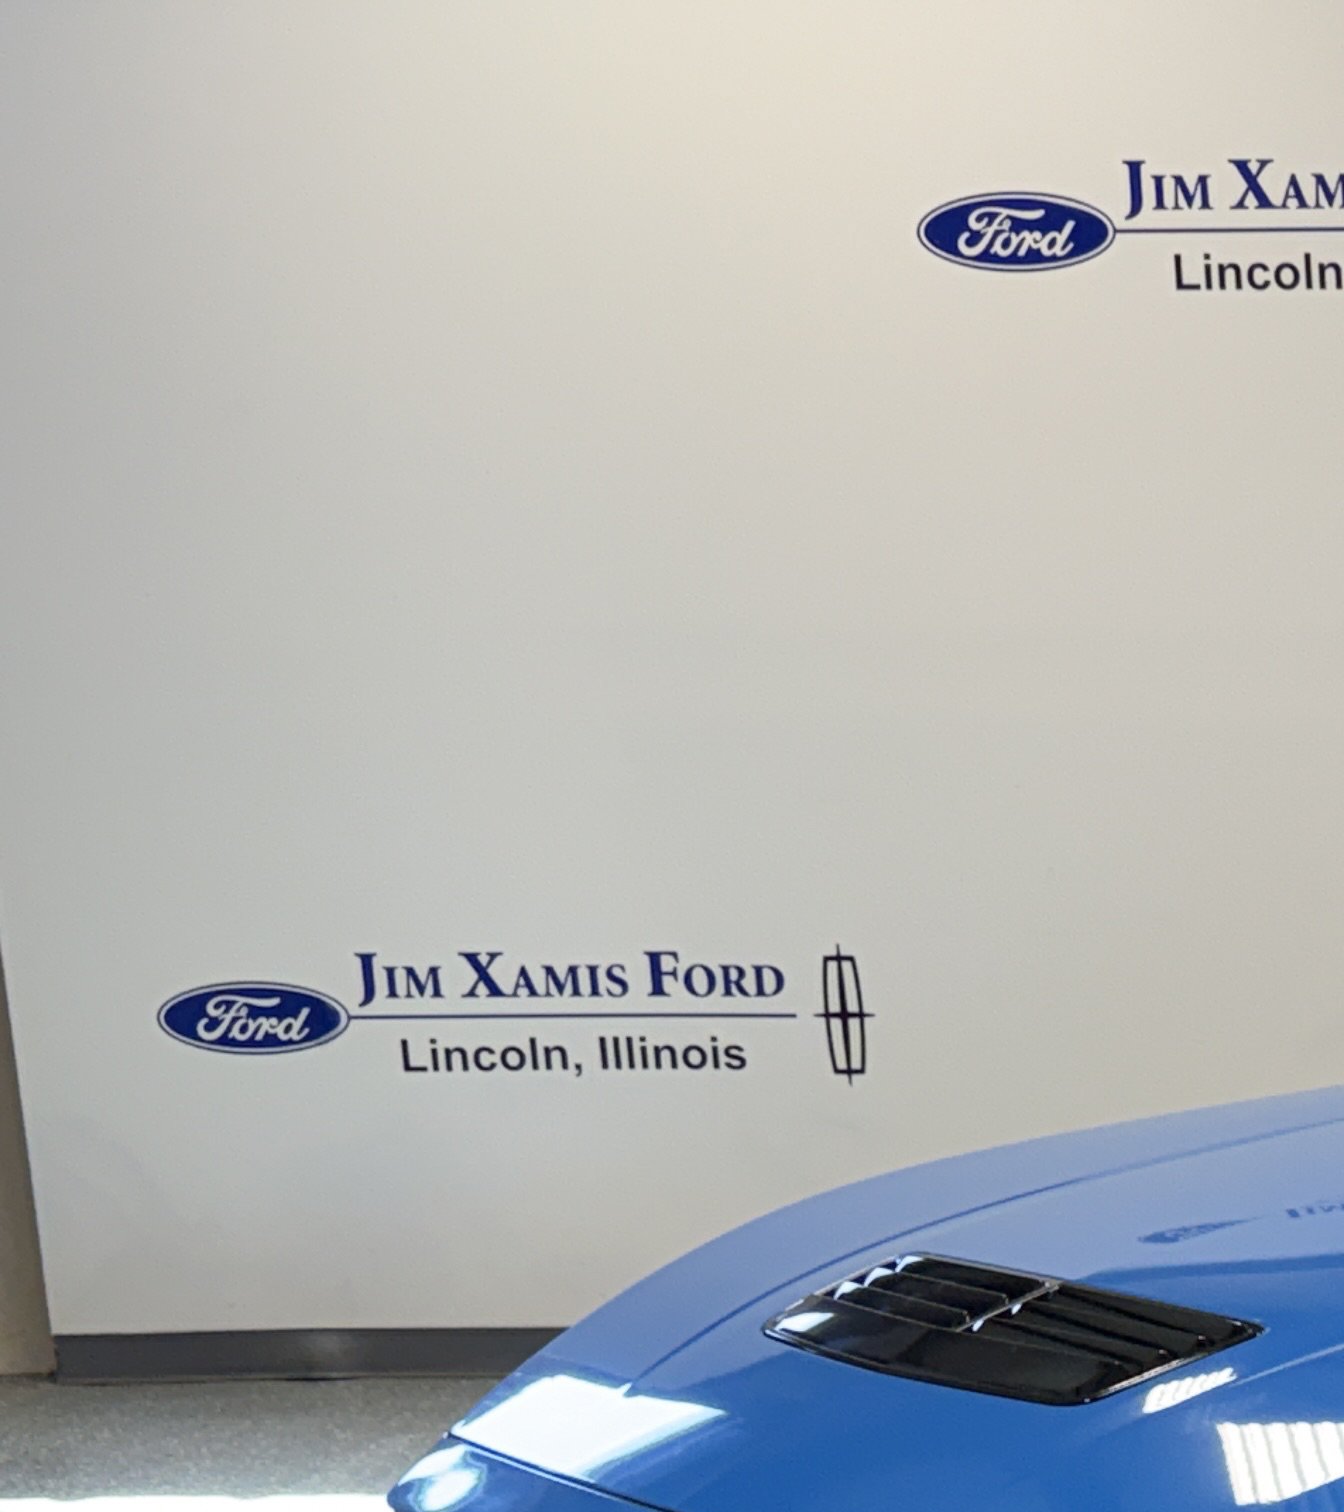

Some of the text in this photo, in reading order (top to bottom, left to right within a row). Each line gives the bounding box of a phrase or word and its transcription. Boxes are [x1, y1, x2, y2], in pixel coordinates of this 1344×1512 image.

[957, 206, 1075, 259] Ford
[196, 993, 312, 1045] Ford
[401, 1036, 747, 1077] Lincoln, Illinois
